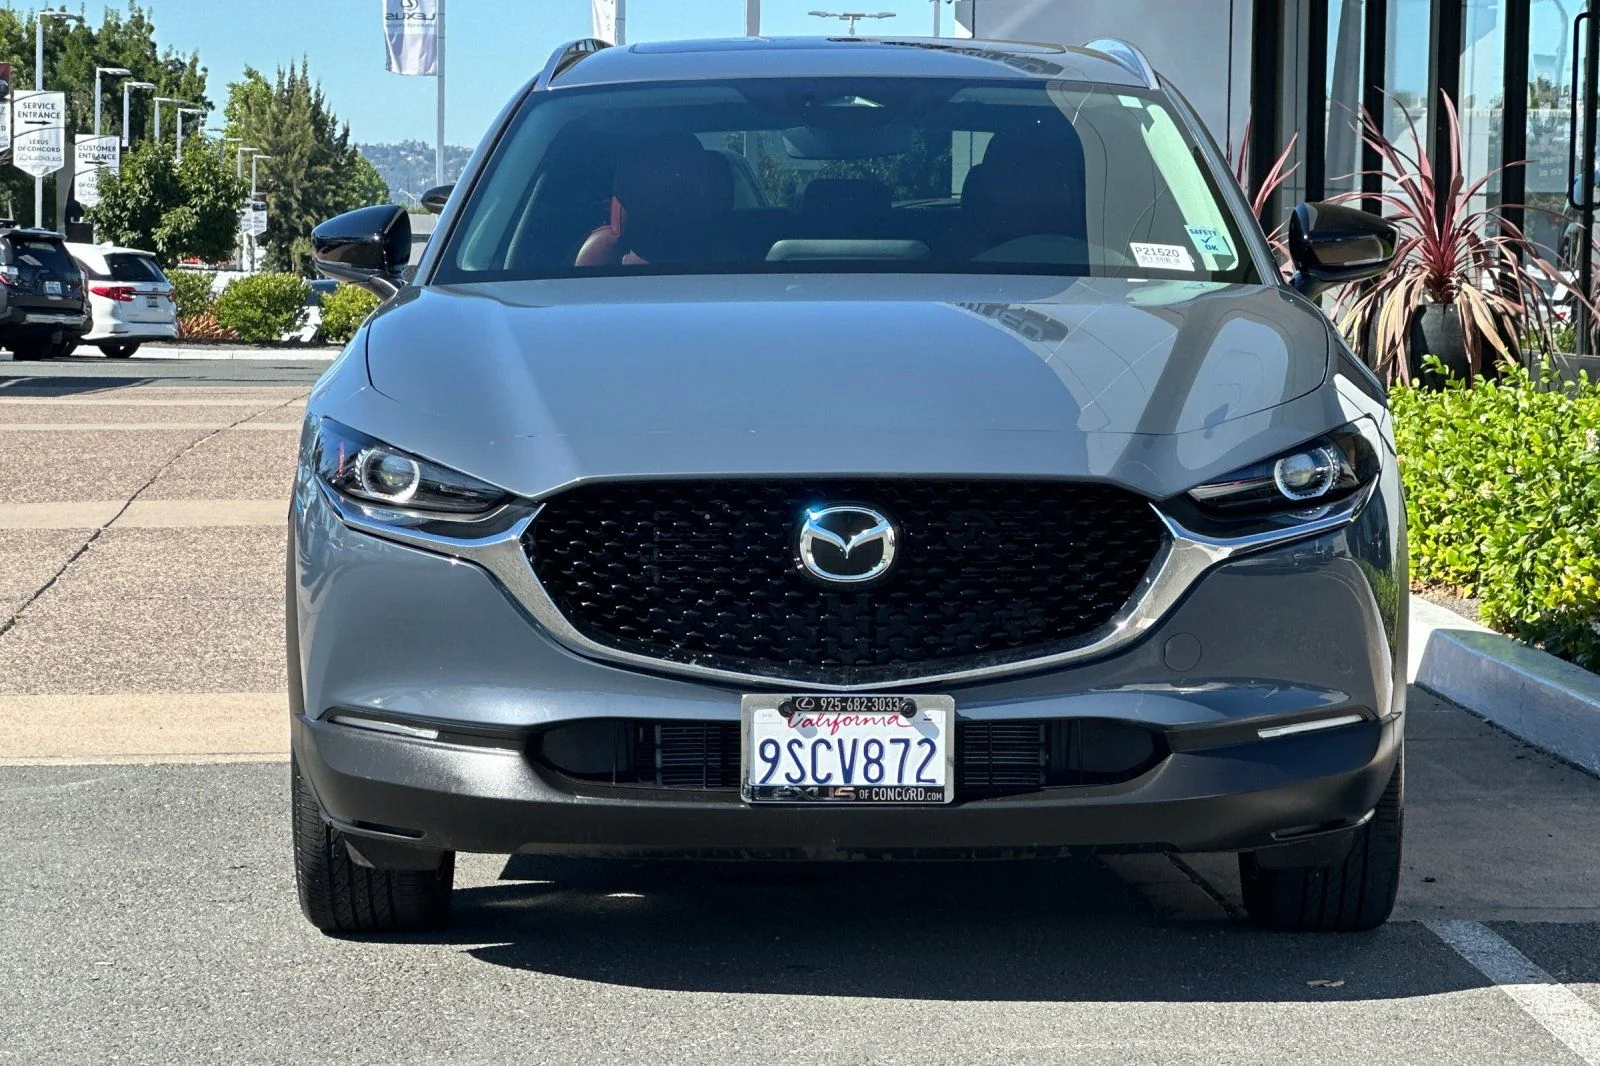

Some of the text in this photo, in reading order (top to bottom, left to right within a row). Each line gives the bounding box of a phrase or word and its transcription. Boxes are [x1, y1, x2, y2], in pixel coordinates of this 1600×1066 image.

[22, 102, 56, 110] SERVICE
[17, 111, 61, 119] ENTRANCE
[1189, 228, 1217, 236] SAFETY
[1135, 246, 1180, 258] P21520
[1204, 244, 1220, 252] OK
[820, 697, 900, 712] 925-682-3033
[786, 712, 915, 736] California
[758, 738, 937, 784] 9SCV872
[859, 789, 870, 800] OF
